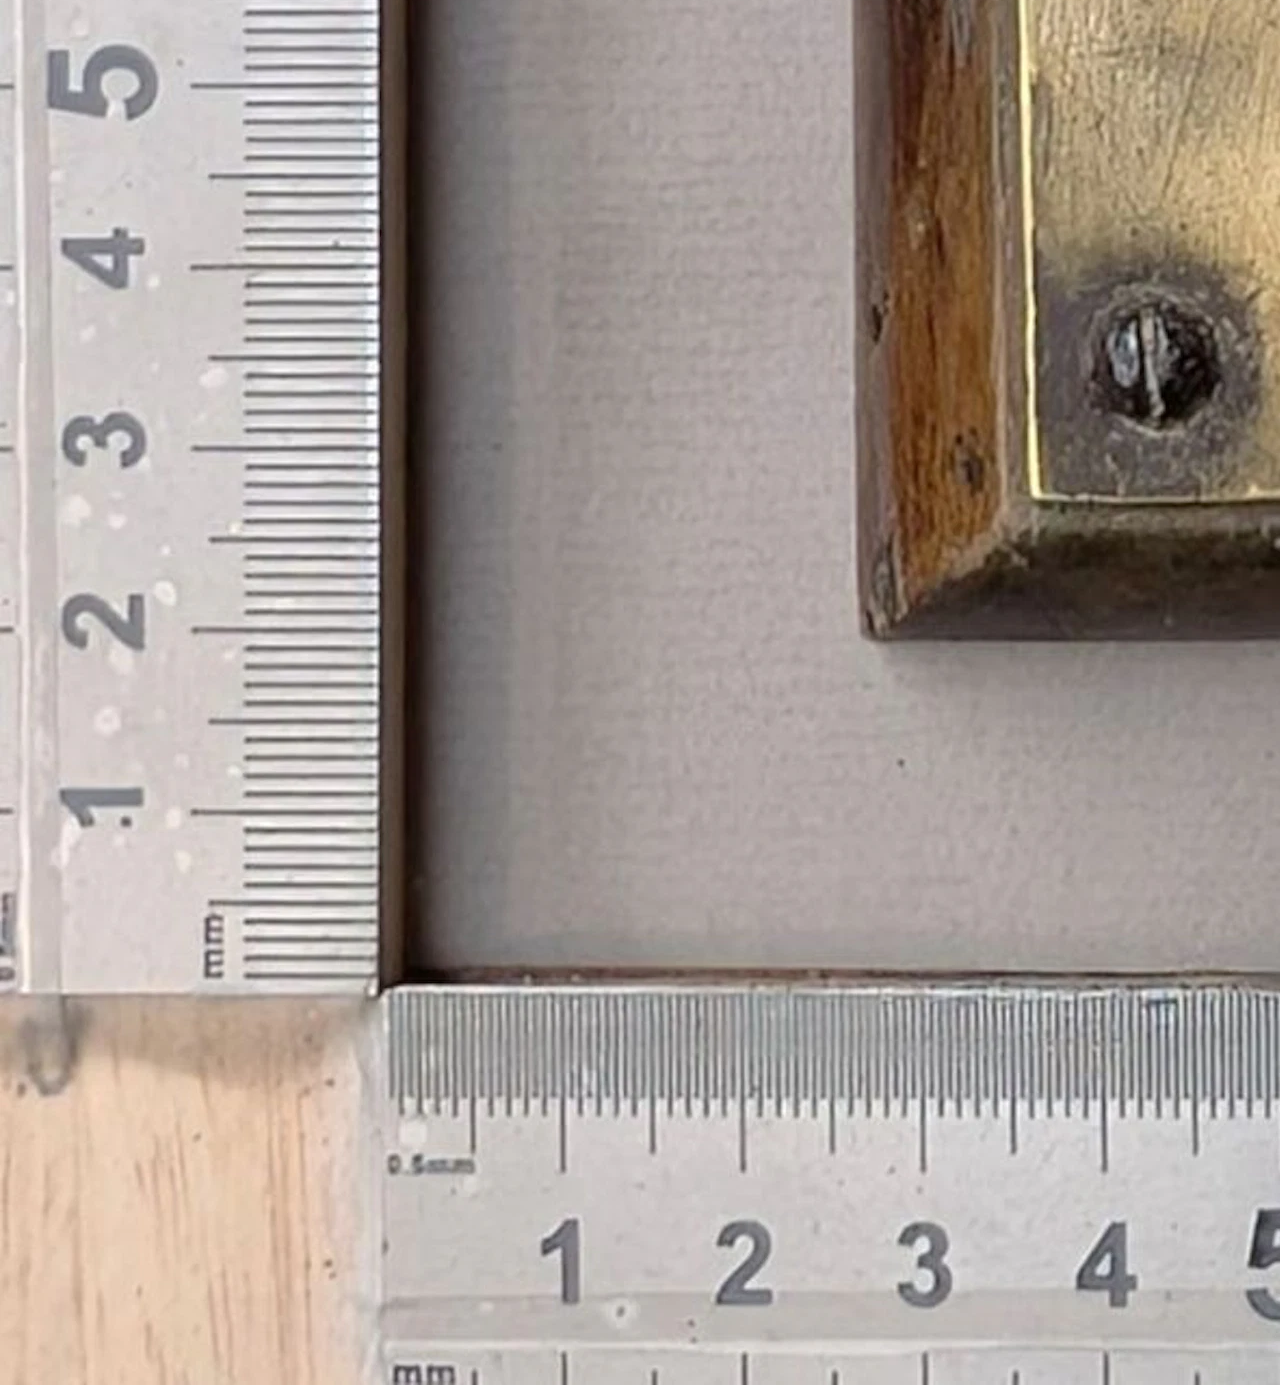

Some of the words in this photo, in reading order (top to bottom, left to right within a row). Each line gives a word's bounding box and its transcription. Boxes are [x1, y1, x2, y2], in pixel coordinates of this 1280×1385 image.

[46, 44, 159, 122] 5
[61, 226, 146, 291] 4
[61, 411, 148, 470] 3
[60, 592, 147, 653] 2
[58, 786, 145, 829] 1
[203, 912, 225, 979] mm
[540, 1217, 581, 1307] 1
[713, 1219, 774, 1308] 2
[896, 1221, 953, 1310] 3
[1074, 1220, 1138, 1309] 4
